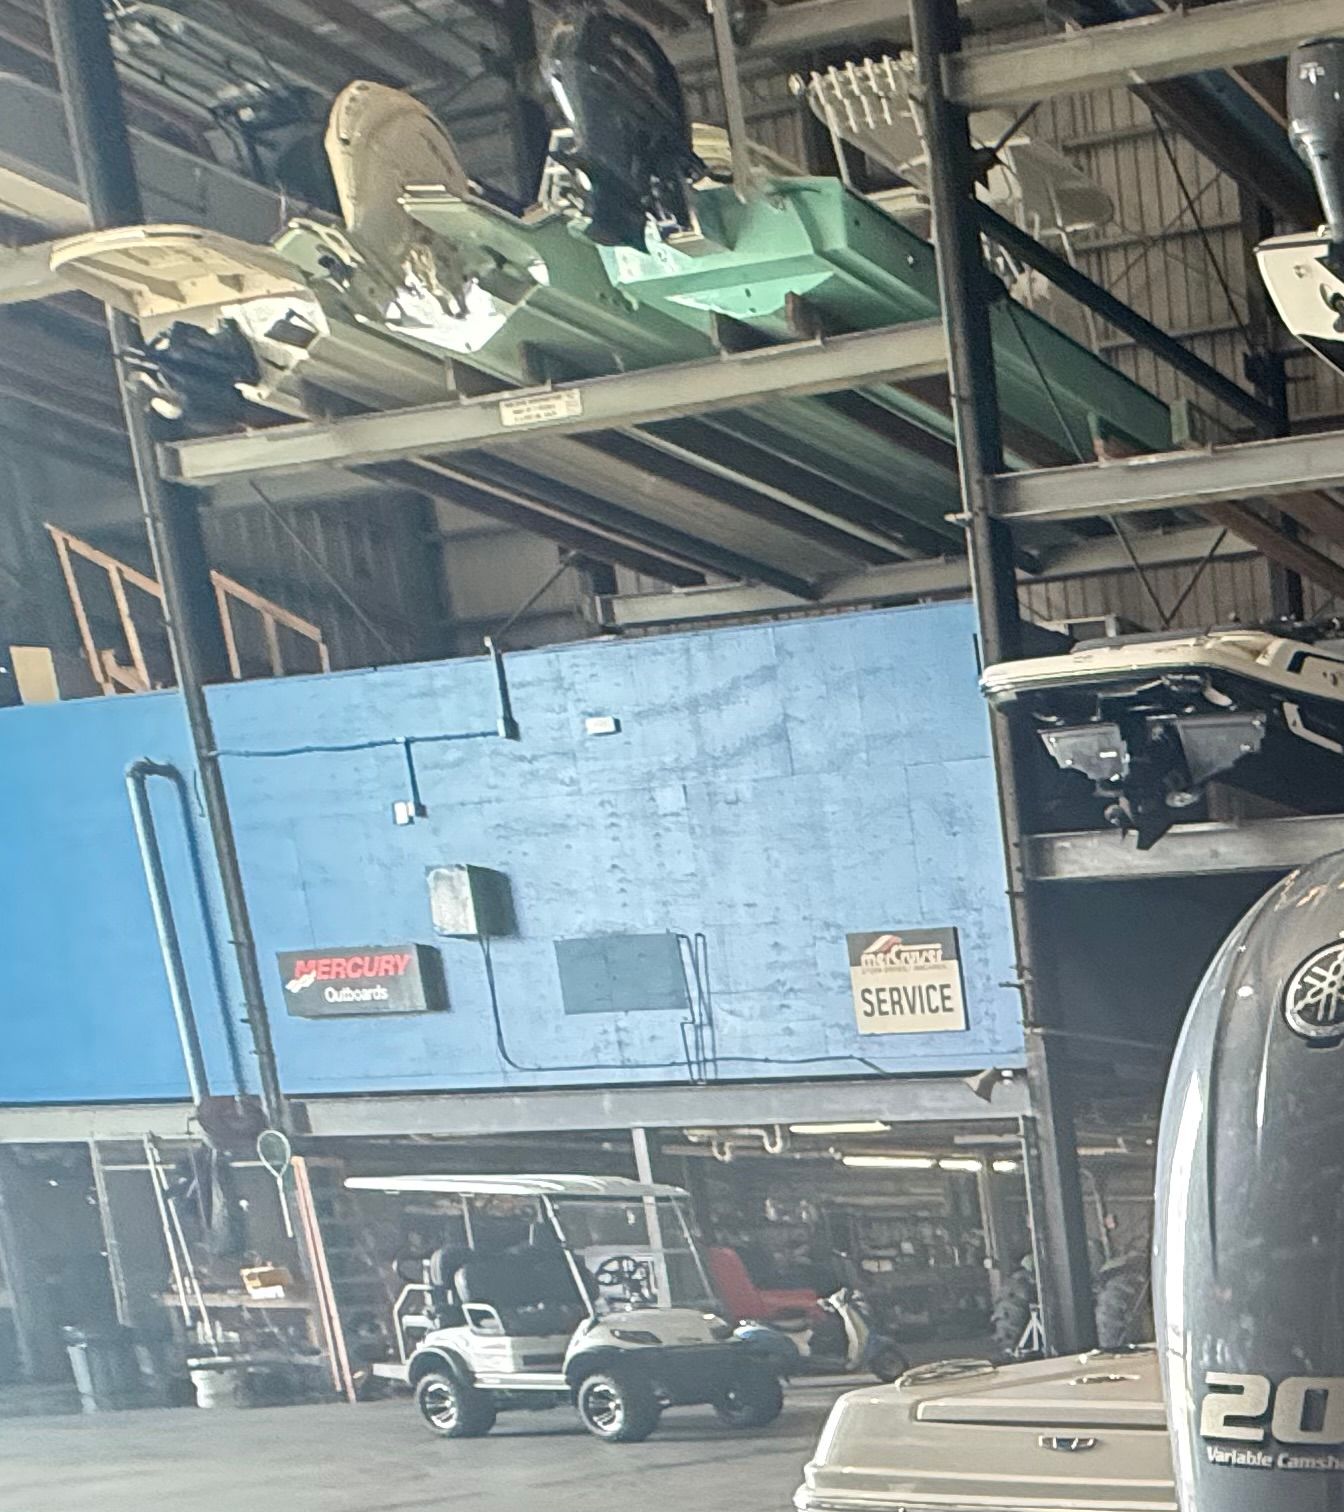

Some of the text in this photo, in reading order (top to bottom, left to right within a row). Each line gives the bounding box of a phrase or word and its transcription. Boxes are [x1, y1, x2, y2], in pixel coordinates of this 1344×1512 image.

[294, 954, 411, 980] MERCURY
[324, 984, 388, 1003] Outboards
[861, 984, 954, 1017] SERVICE
[1206, 1446, 1273, 1468] Variable
